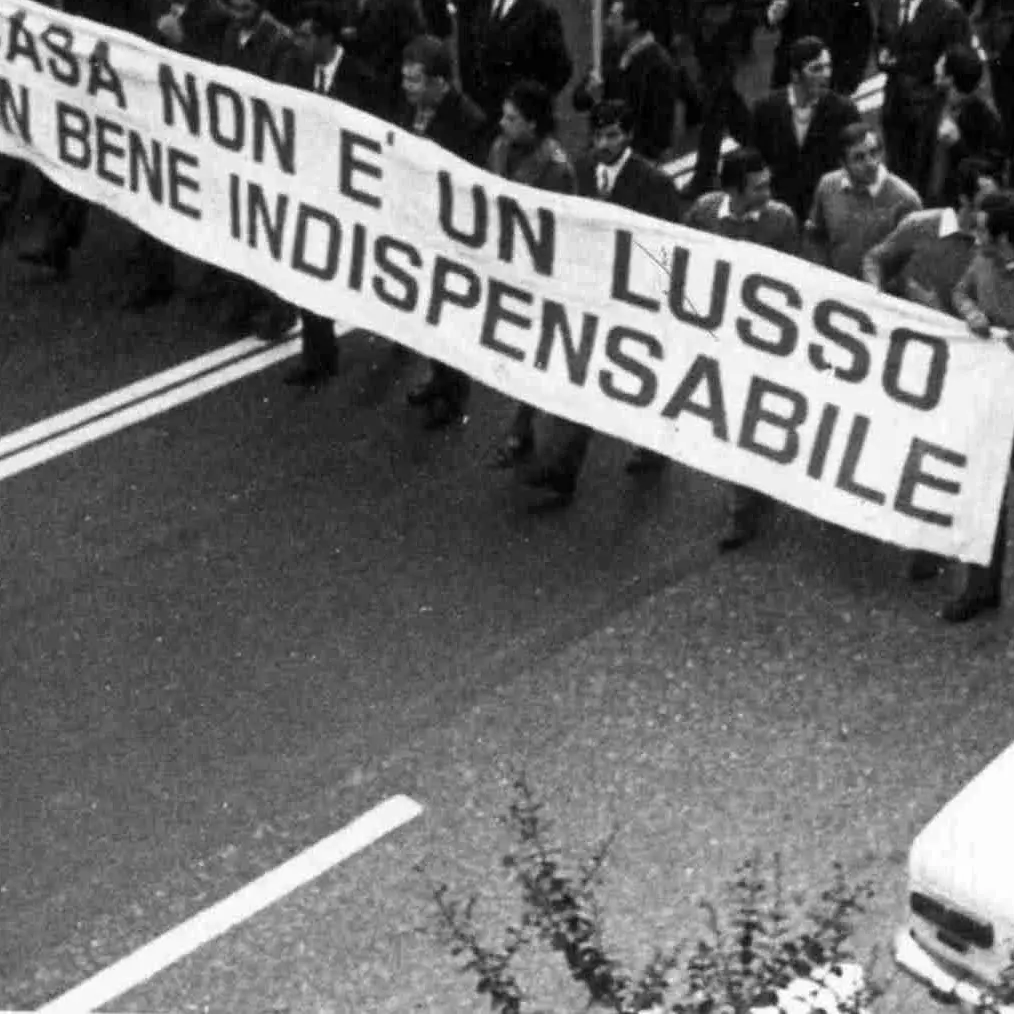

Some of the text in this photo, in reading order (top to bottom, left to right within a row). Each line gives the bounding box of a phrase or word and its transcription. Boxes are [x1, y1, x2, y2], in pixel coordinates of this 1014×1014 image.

[0, 76, 967, 529] N BENE INDISPENSABILE
[3, 9, 950, 412] ASA NON E' UN LUSSO
